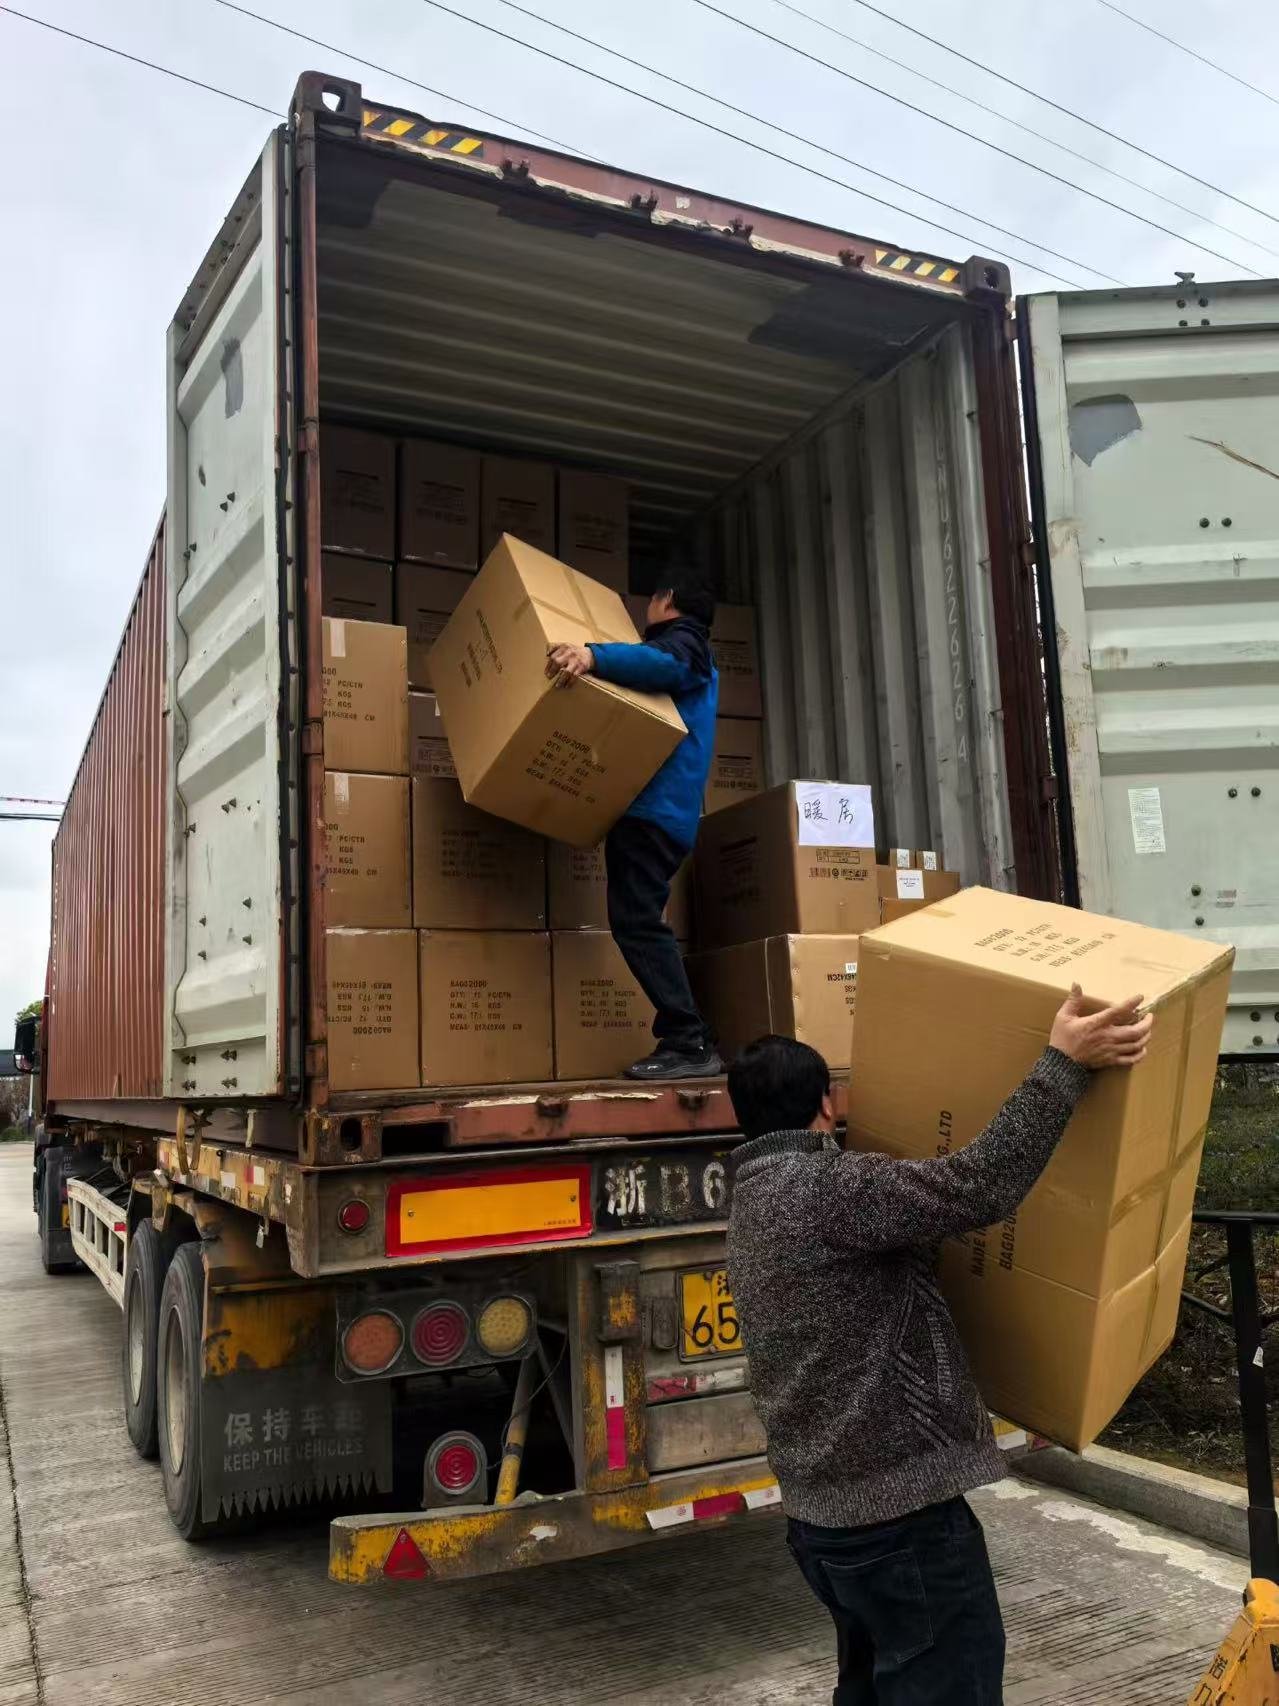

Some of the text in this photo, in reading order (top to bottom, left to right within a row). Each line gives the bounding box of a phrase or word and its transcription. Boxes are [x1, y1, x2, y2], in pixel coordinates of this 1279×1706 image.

[936, 1110, 953, 1158] G.,LTD
[692, 1301, 740, 1348] 65
[223, 1449, 260, 1473] KEEP
